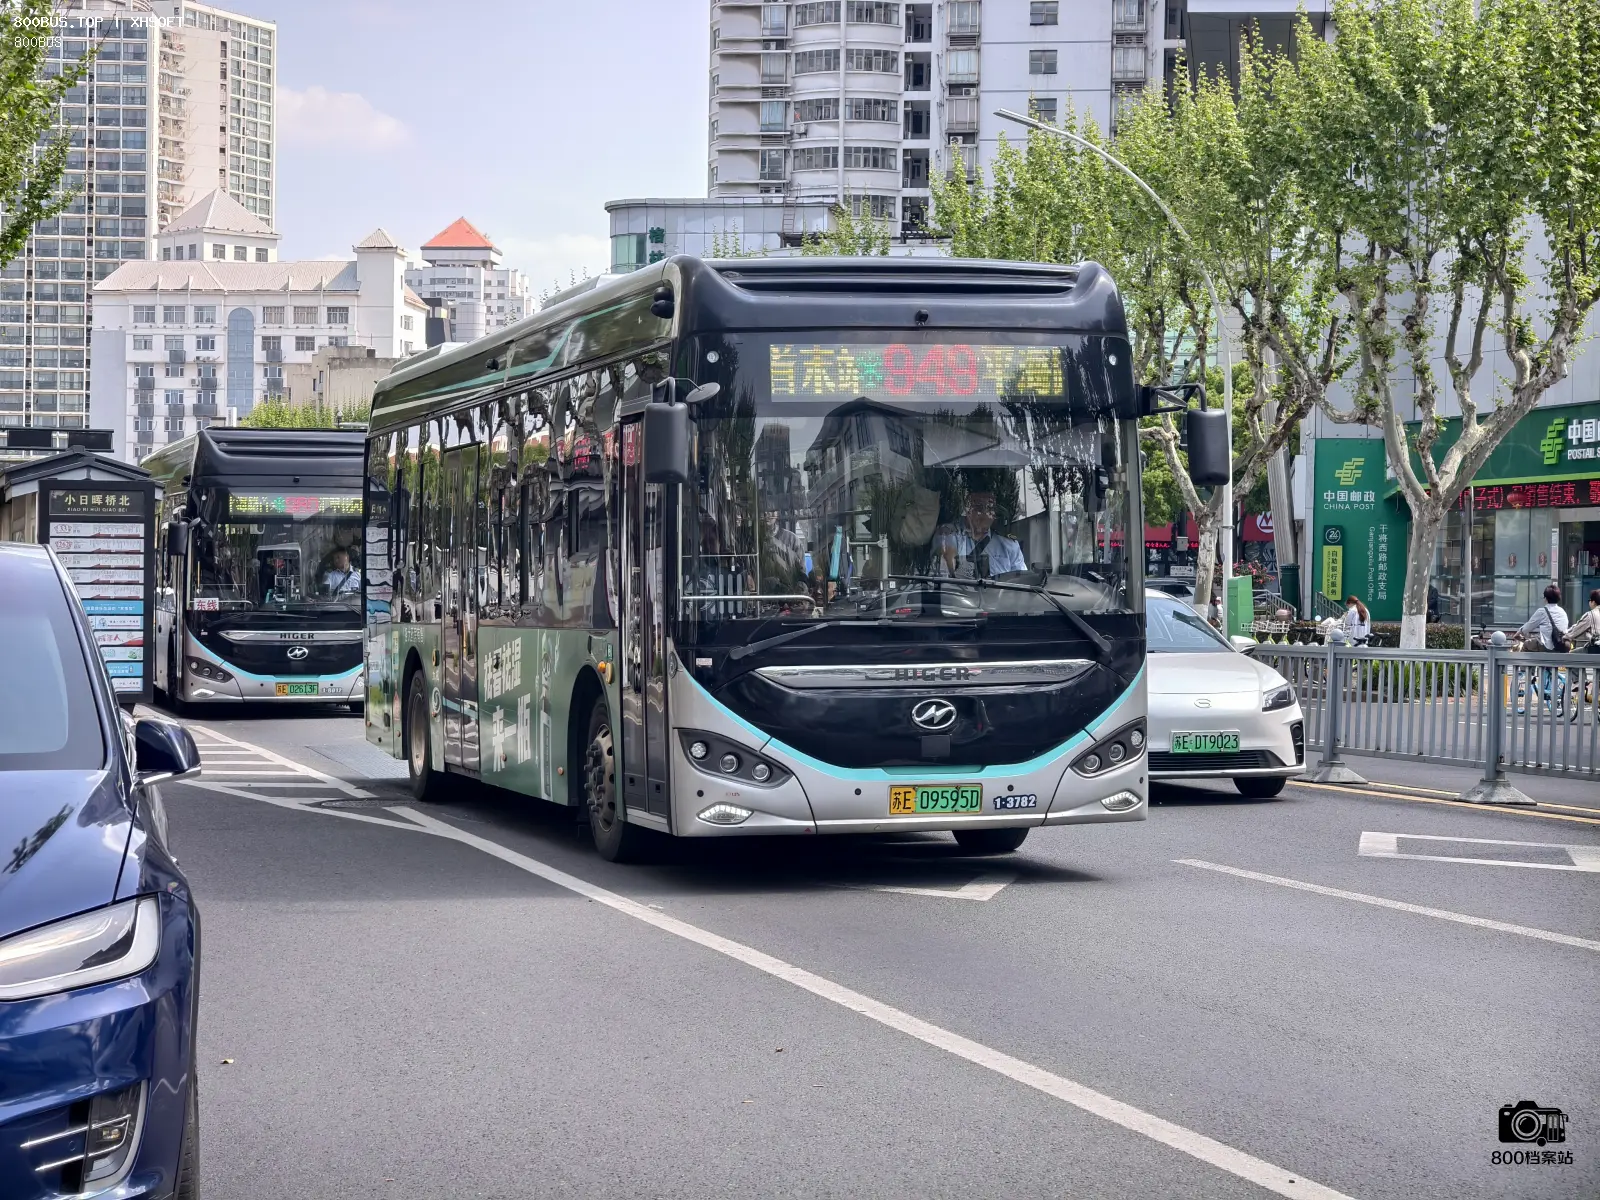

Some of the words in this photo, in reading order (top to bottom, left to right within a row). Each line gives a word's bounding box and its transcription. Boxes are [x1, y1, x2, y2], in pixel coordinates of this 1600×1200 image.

[883, 344, 978, 395] 949
[1568, 418, 1600, 445] 中国
[64, 494, 130, 506] 小日晖桥北
[1323, 490, 1375, 502] 中国邮政
[1323, 503, 1350, 511] CHINA
[1353, 503, 1375, 511] POST
[1377, 524, 1388, 600] 干将西路邮政支局
[1367, 567, 1375, 582] Post
[195, 600, 217, 611] 东线
[895, 667, 970, 681] HIGER
